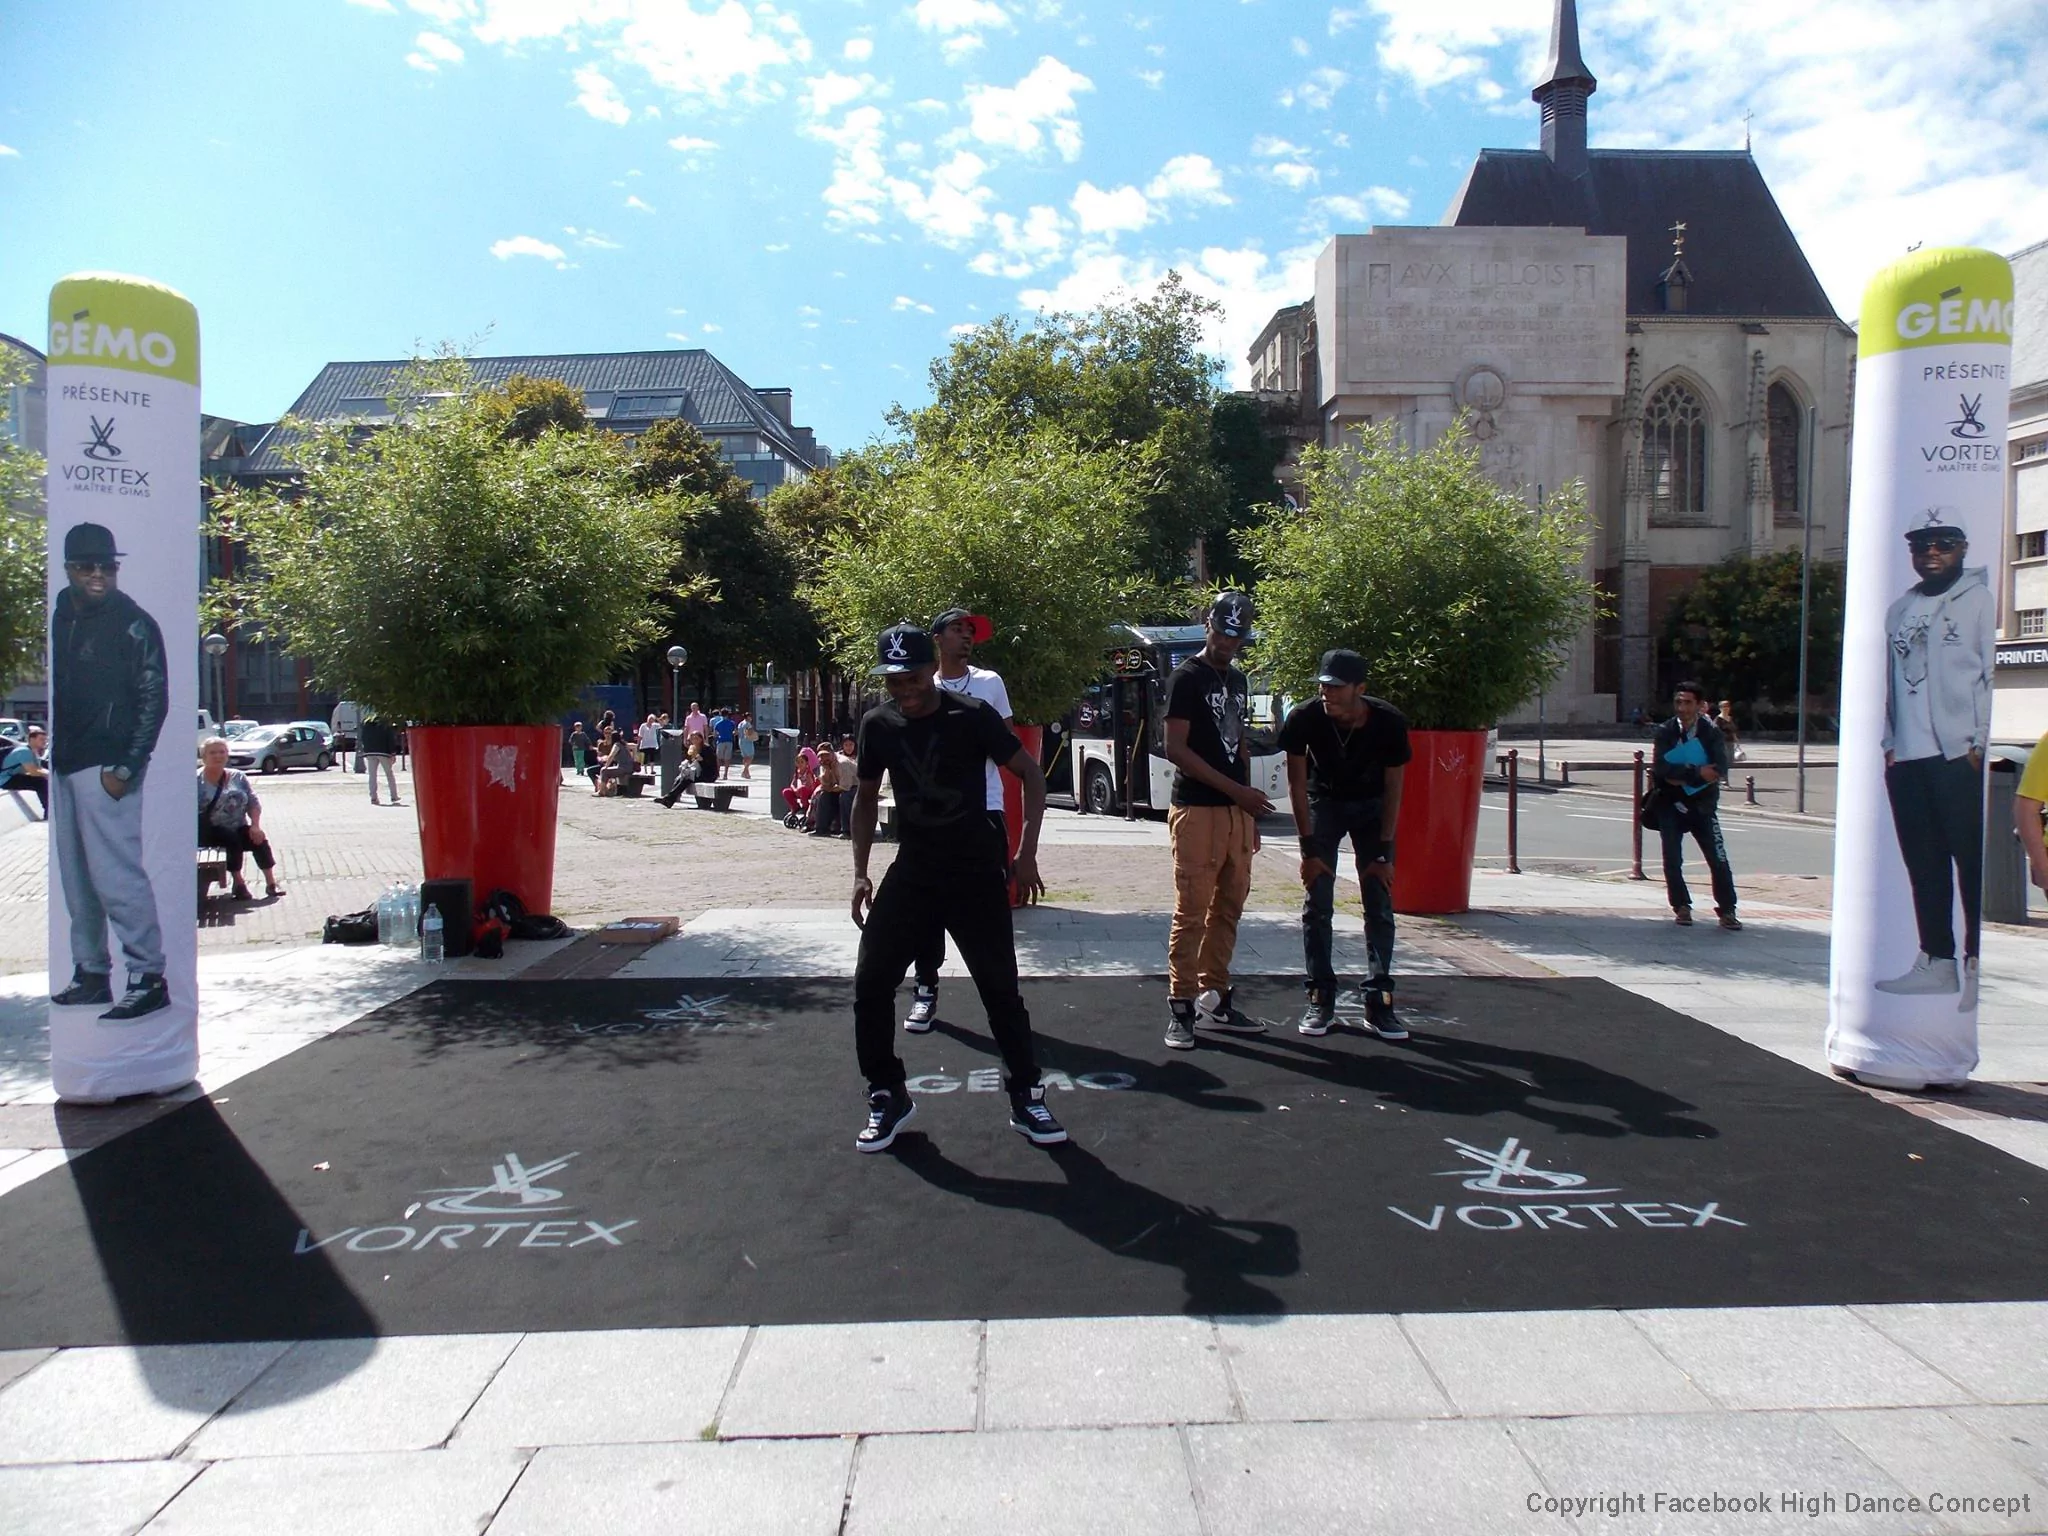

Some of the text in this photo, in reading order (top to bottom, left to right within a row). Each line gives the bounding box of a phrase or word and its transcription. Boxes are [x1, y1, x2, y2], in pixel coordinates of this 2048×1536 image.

[1399, 263, 1566, 286] AVX LILLOIS
[49, 309, 177, 367] GÉMO
[1923, 361, 2006, 382] PRÉSENTE
[63, 382, 151, 408] PRÉSENTE
[1921, 444, 2001, 462] VORTEX
[62, 464, 150, 487] VORTEX
[119, 486, 151, 498] GIMS
[1387, 1202, 1749, 1231] VORTEX
[294, 1218, 640, 1254] VORTEX
